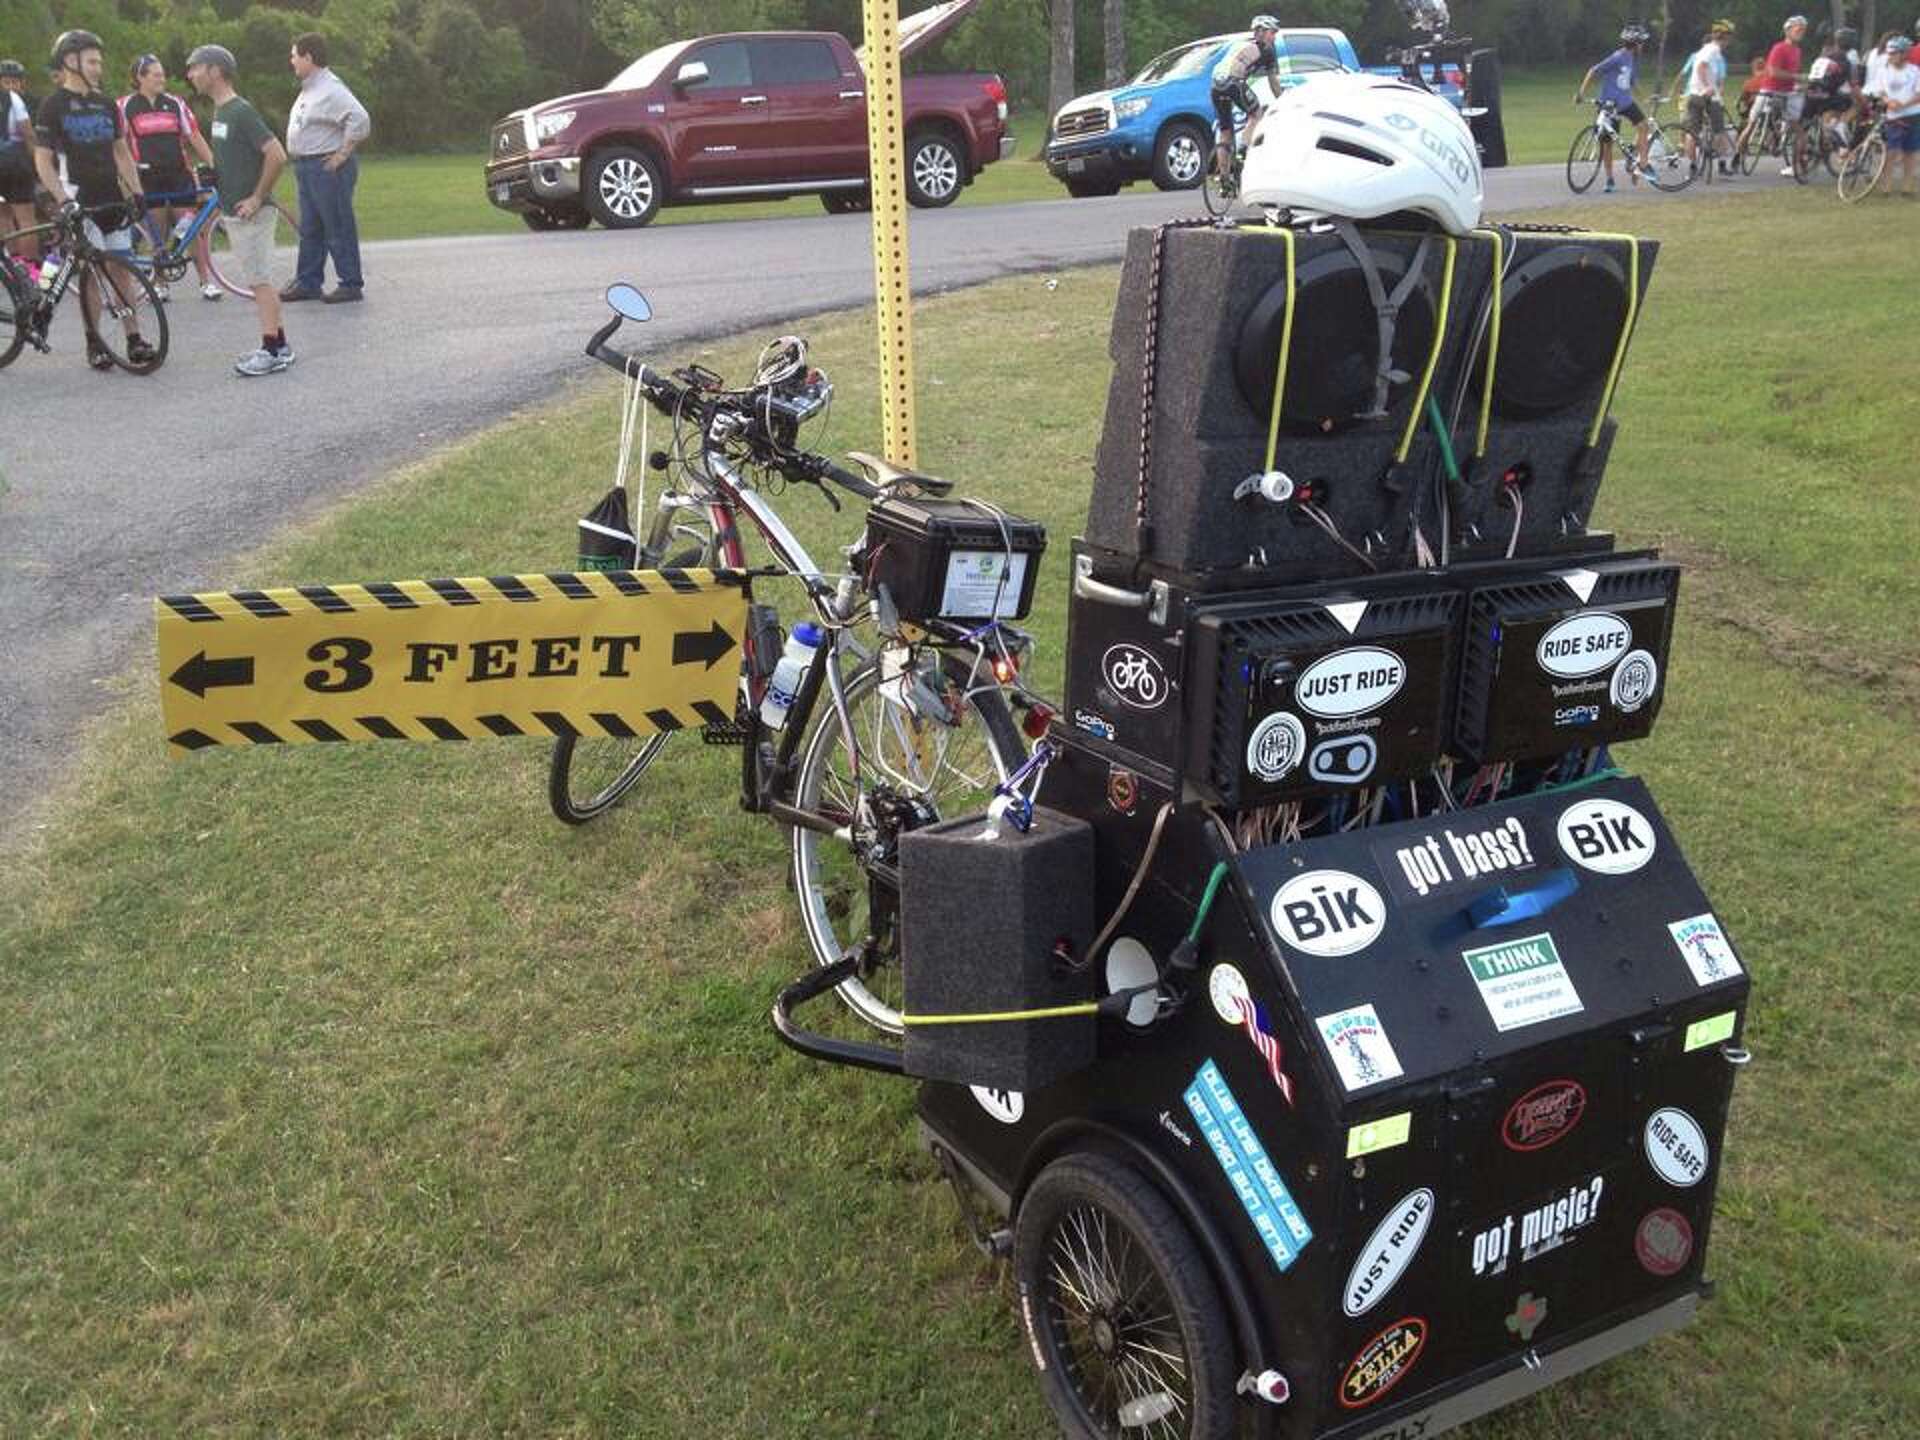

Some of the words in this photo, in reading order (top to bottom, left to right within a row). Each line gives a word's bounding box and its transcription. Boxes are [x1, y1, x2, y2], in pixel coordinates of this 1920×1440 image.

[1420, 129, 1469, 183] GIRO
[302, 635, 375, 694] 3
[402, 634, 641, 684] FEET
[1543, 637, 1582, 659] RIDE
[1585, 631, 1625, 653] SAFE
[1303, 673, 1353, 699] JUST
[1356, 667, 1399, 690] RIDE
[1396, 835, 1452, 896] got
[1445, 816, 1534, 878] bass?
[1477, 942, 1548, 976] THINK
[1651, 1116, 1677, 1152] RIDE
[1673, 1143, 1703, 1178] SAFE
[1352, 1249, 1391, 1308] JUST
[1389, 1196, 1428, 1248] RIDE
[1472, 1215, 1515, 1275] got
[1520, 1176, 1604, 1249] music?
[1348, 1329, 1419, 1397] YELLA
